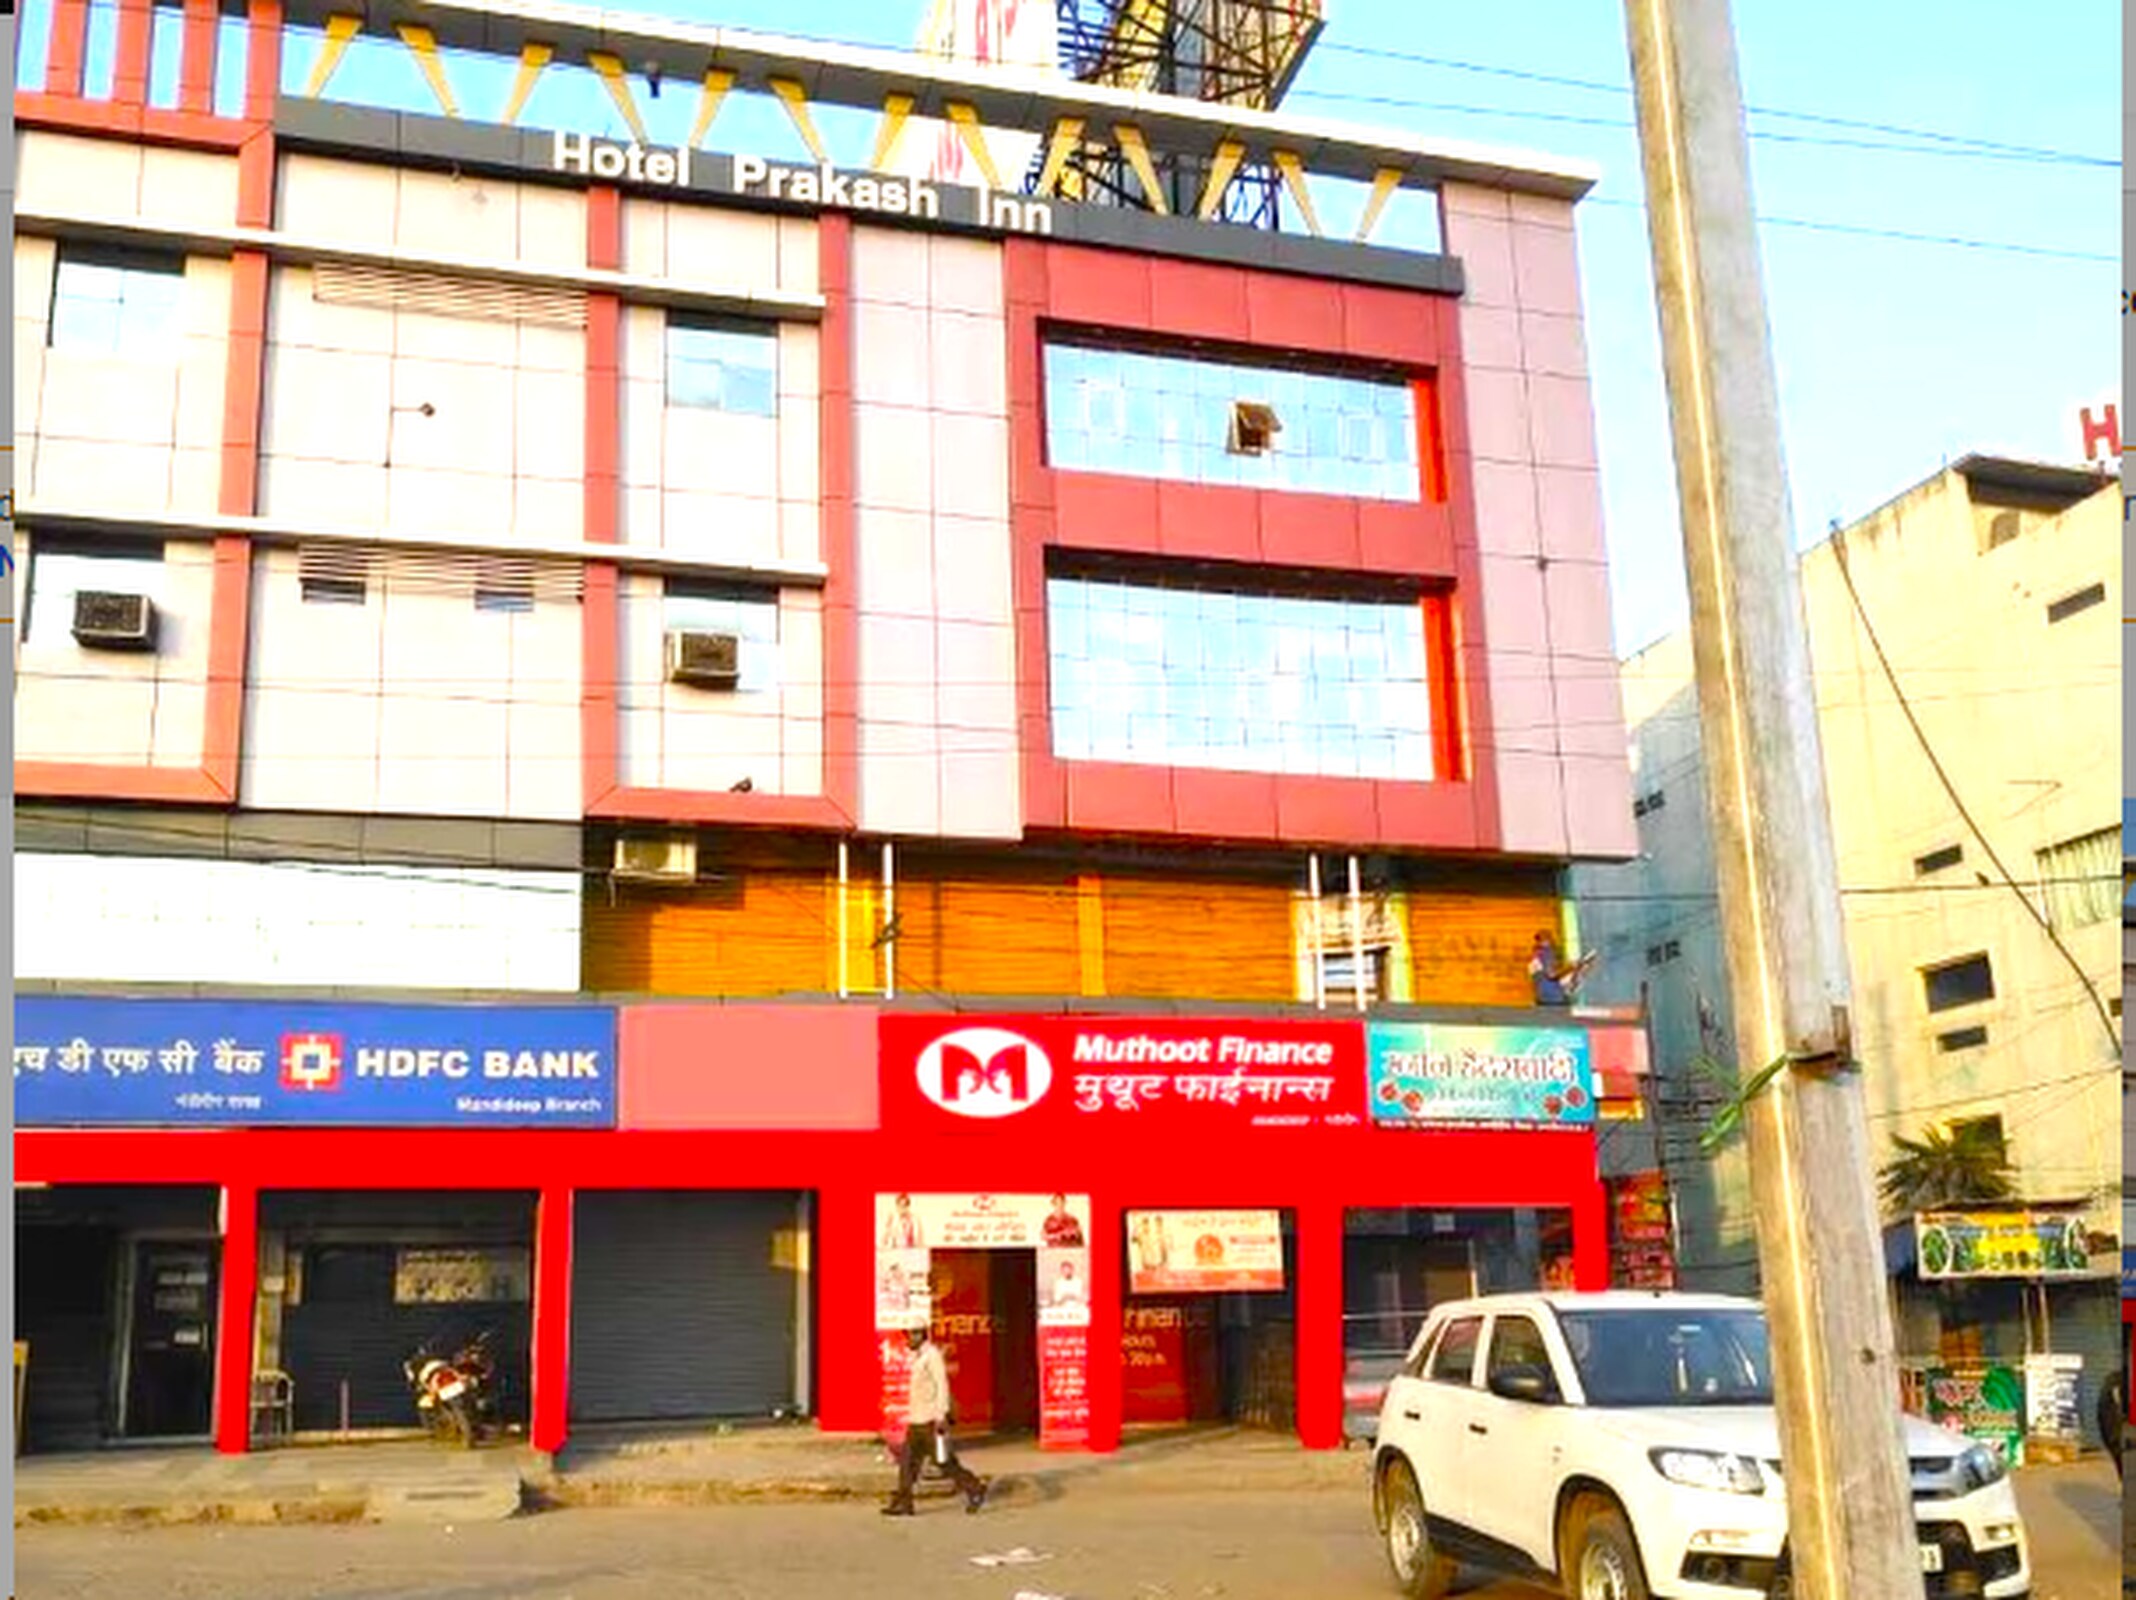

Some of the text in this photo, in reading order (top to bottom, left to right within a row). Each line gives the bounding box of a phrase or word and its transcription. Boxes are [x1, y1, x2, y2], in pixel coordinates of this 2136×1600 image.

[553, 130, 691, 187] Hotel
[732, 153, 939, 219] Prakash
[977, 183, 1053, 235] Inn
[57, 1037, 95, 1073] डी
[102, 1046, 151, 1077] एफ
[158, 1039, 200, 1073] सी
[212, 1037, 265, 1073] बैंक
[356, 1048, 600, 1079] HDFC BANK
[1073, 1034, 1334, 1065] Muthoot Finance
[1073, 1065, 1336, 1112] मुथूट फाईनान्स
